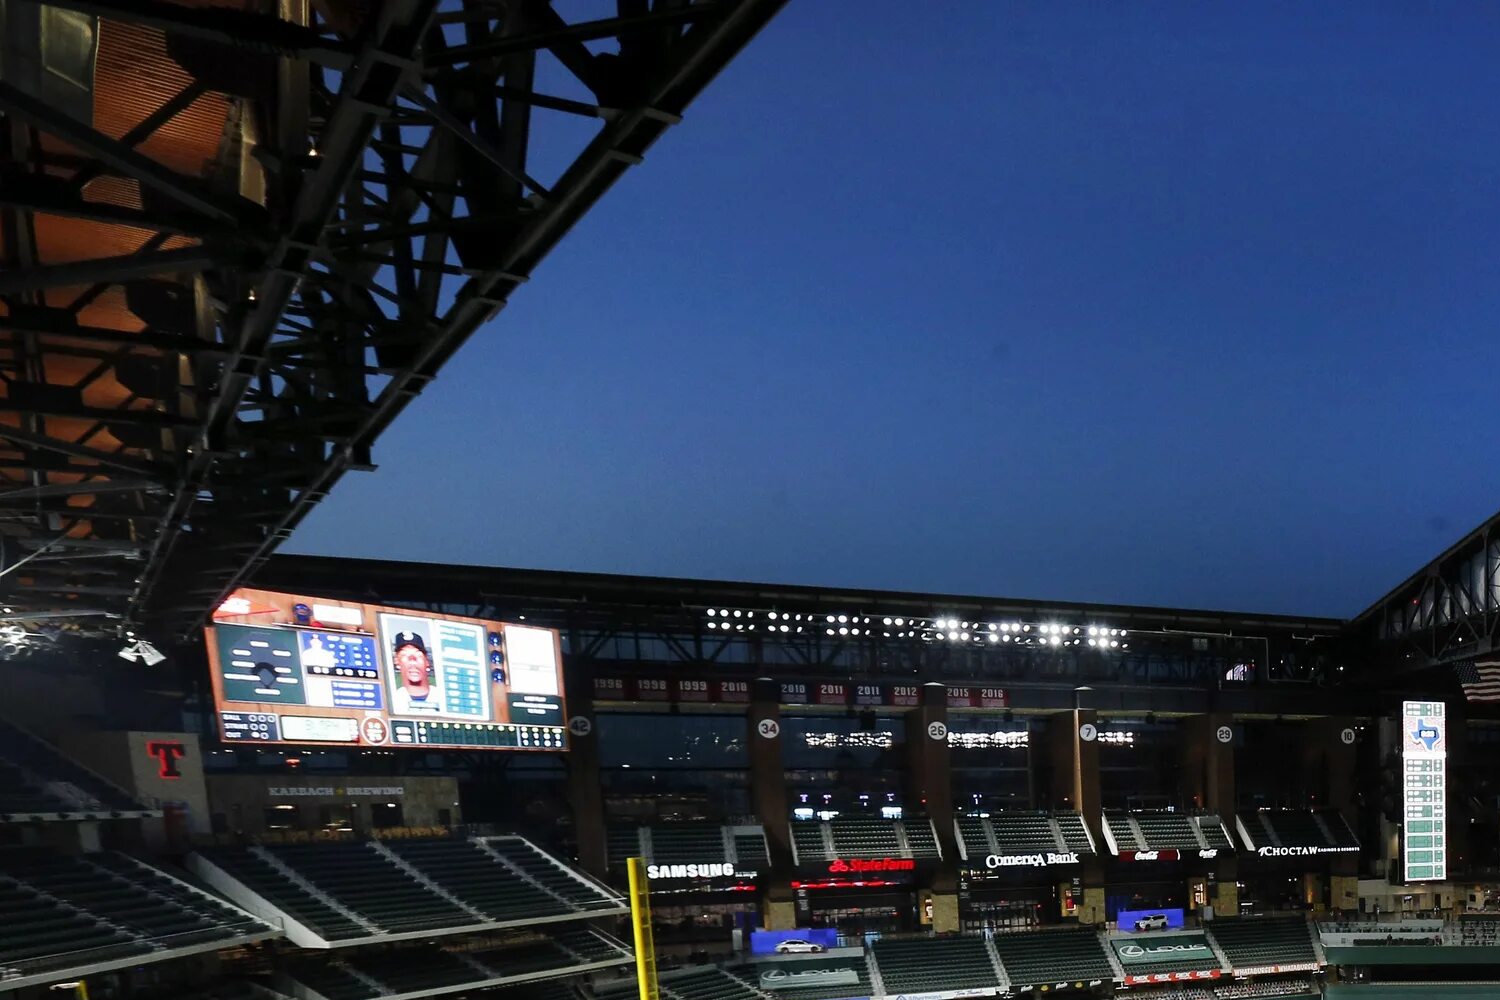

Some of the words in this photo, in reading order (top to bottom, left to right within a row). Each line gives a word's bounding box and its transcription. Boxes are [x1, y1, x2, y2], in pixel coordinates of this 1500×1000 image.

[638, 680, 667, 690] 1998
[679, 681, 708, 691] 1999
[721, 682, 748, 691] 2010
[781, 684, 805, 694] 2010
[821, 685, 843, 694] 2011
[857, 686, 880, 695] 2011
[894, 687, 917, 696] 2012
[947, 688, 969, 697] 2015
[981, 689, 1004, 698] 2016
[761, 723, 777, 734] 34
[930, 725, 944, 736] 26
[1085, 728, 1092, 738] 7
[1218, 729, 1231, 739] 29
[146, 739, 184, 780] T
[268, 787, 334, 796] KARBACH
[347, 787, 404, 796] BREWING
[1263, 846, 1318, 857] CHOCTAW
[1048, 851, 1079, 865] Bank
[647, 863, 734, 879] SAMSUNG
[1145, 943, 1207, 954] LEXUS
[1234, 967, 1273, 976] WHATABURGER
[1279, 963, 1318, 972] WHATABURGER
